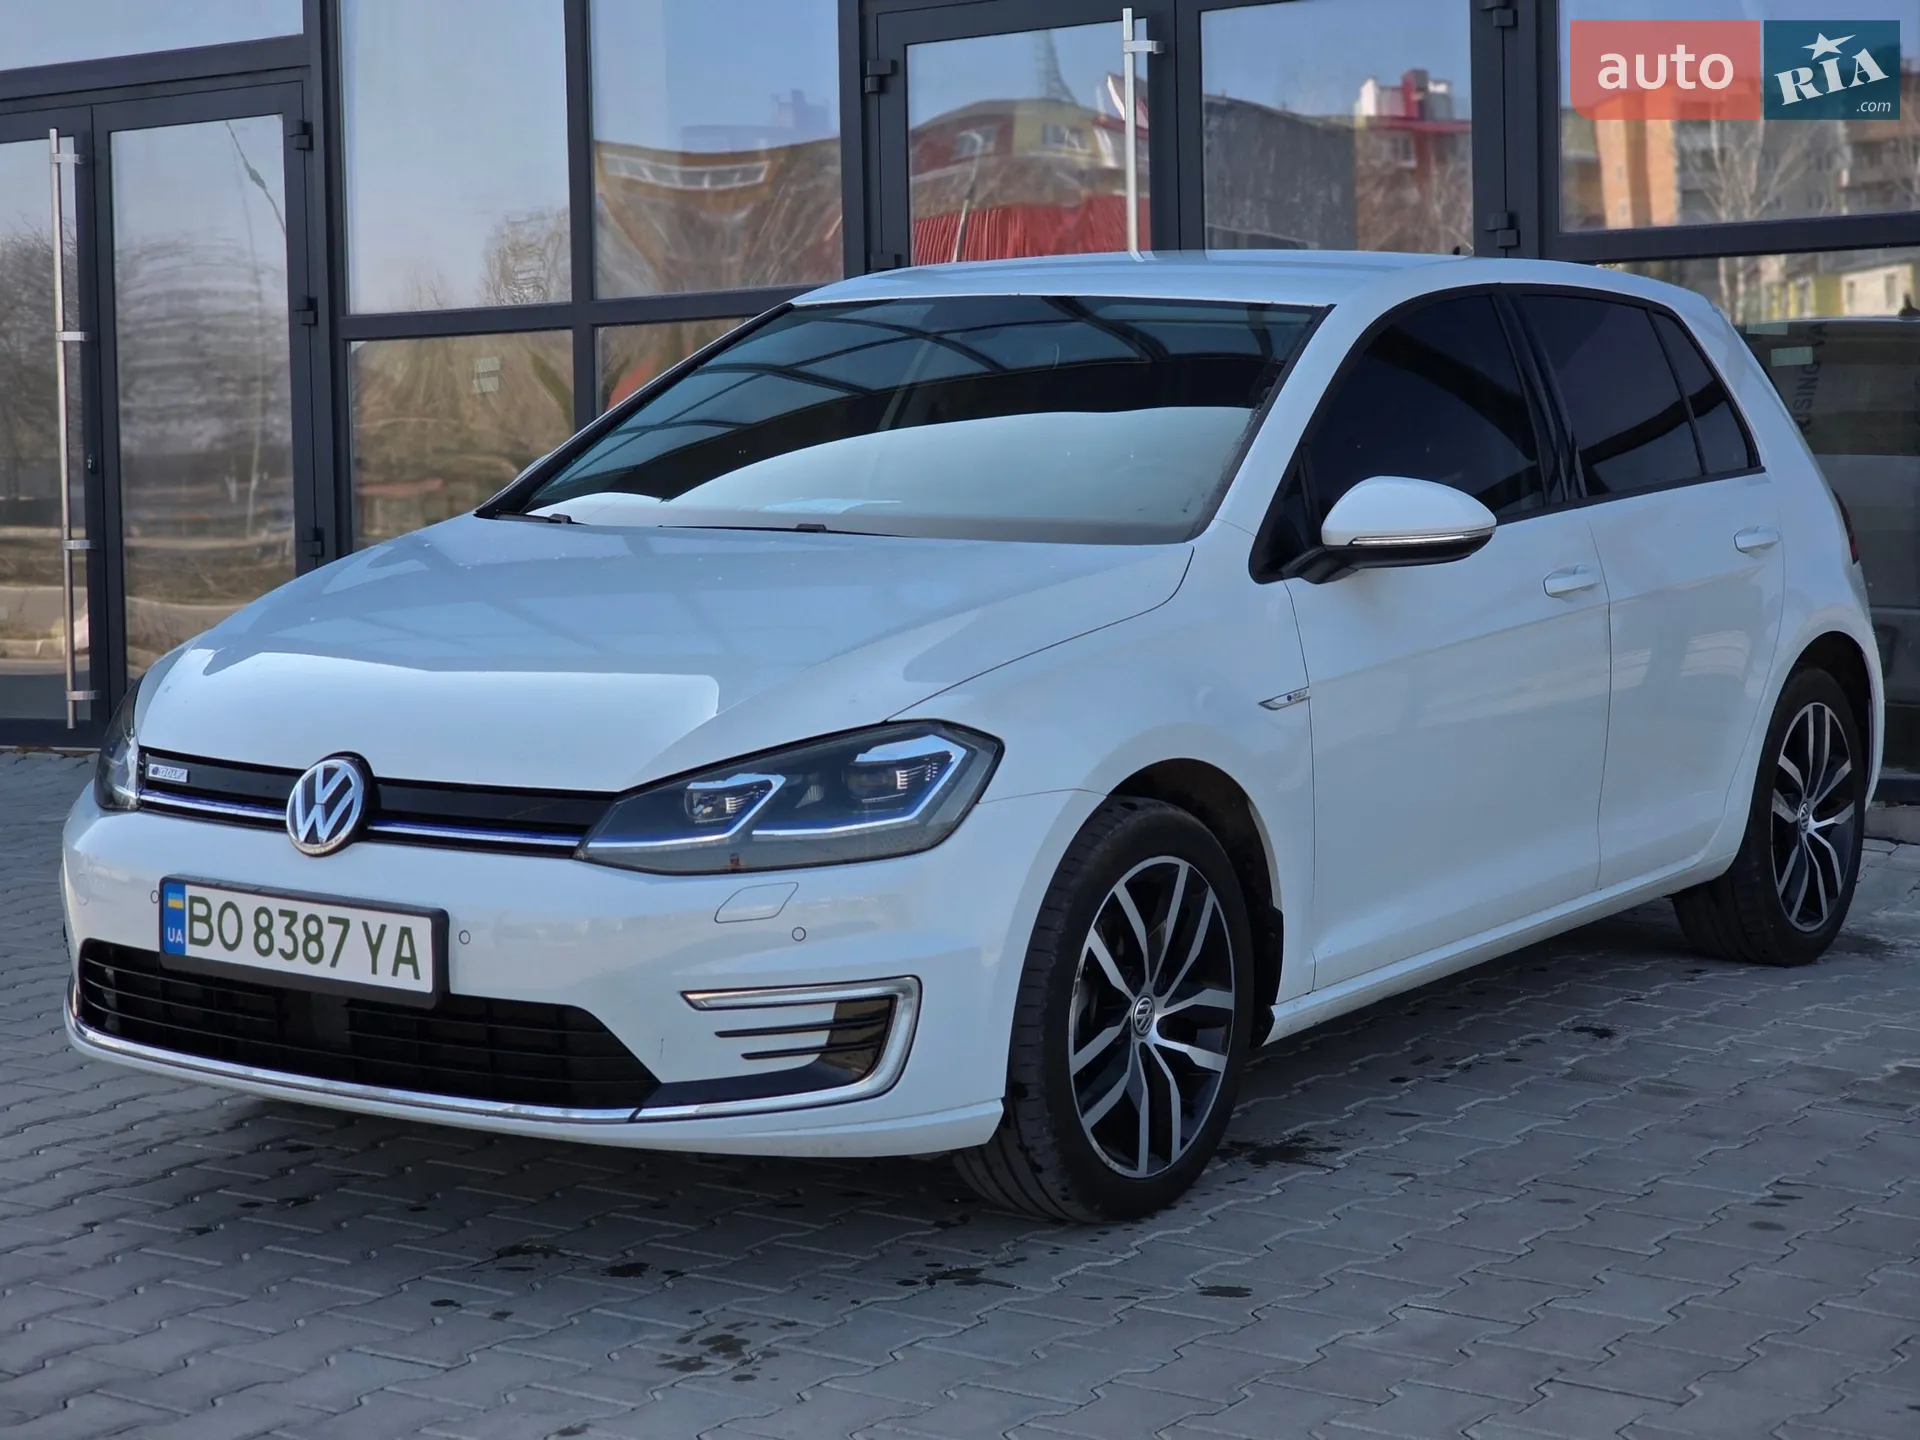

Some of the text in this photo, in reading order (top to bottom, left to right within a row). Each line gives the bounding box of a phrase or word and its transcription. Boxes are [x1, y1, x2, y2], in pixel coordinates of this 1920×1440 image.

[167, 927, 184, 945] UA
[188, 895, 421, 981] BO 8387 YA
